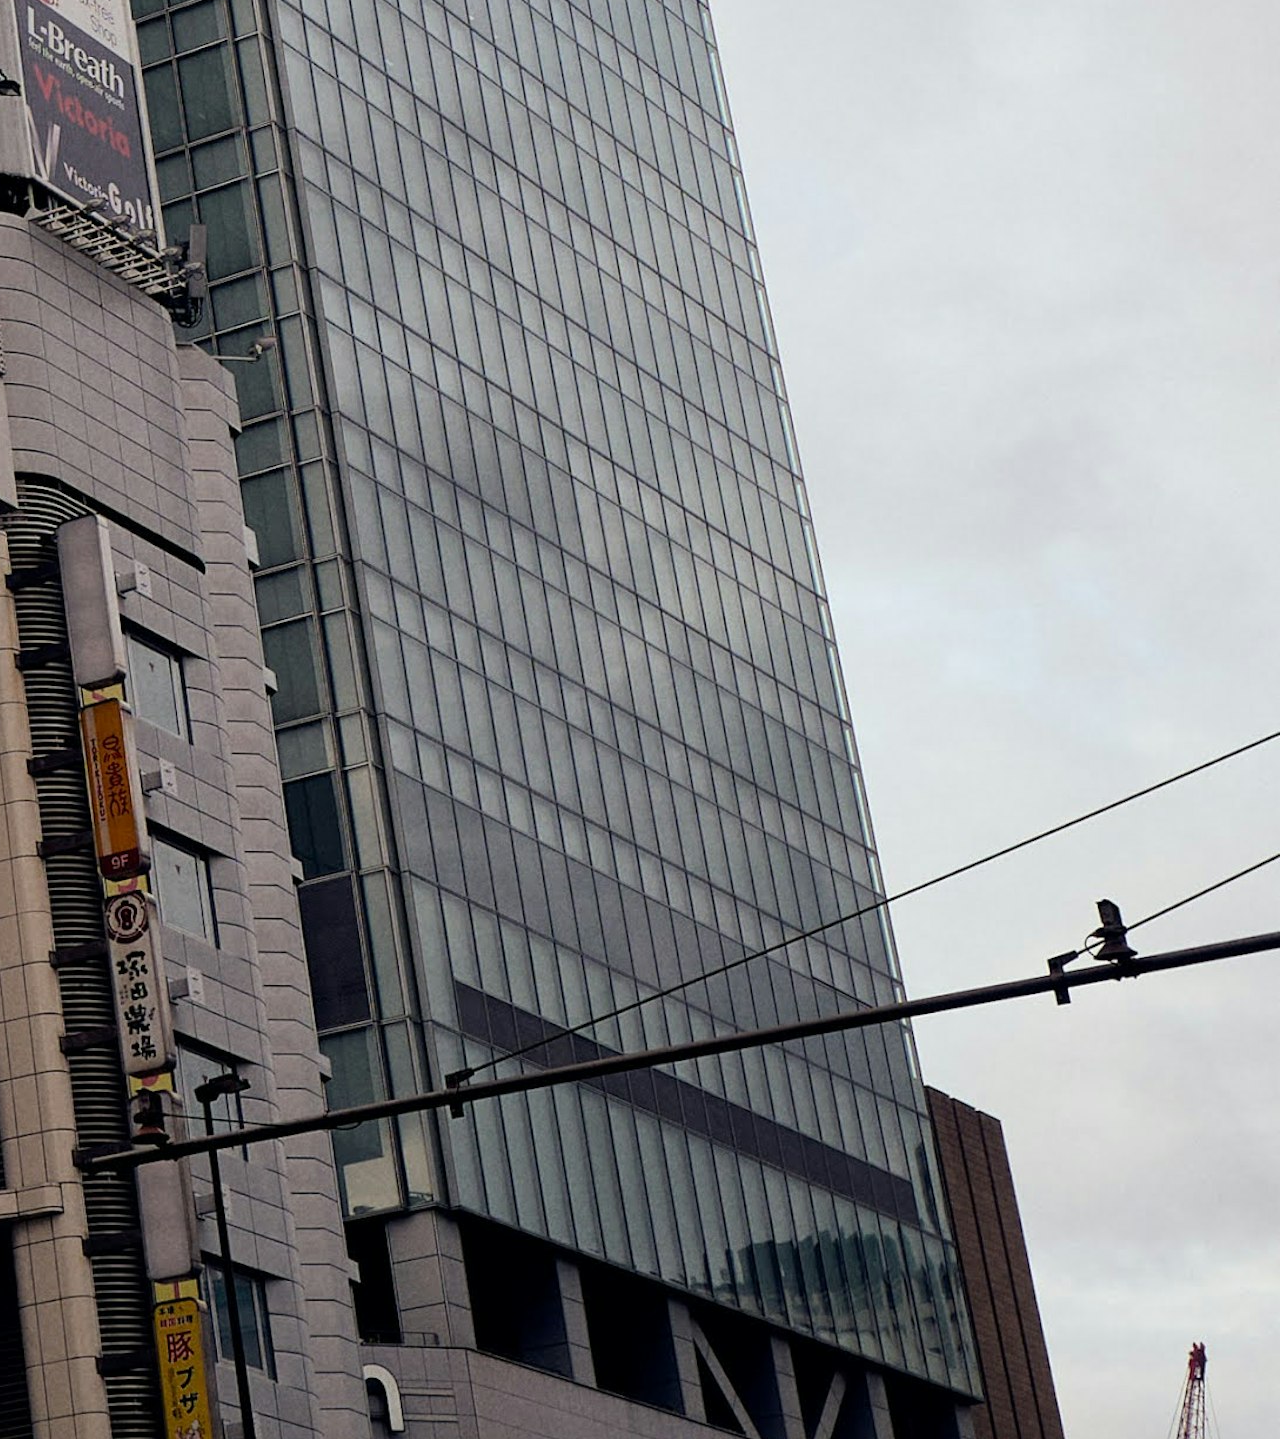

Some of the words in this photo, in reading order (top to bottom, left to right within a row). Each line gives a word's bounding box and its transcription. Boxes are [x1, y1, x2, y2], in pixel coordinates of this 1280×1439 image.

[26, 4, 125, 99] L-Breath
[34, 63, 131, 160] Victoria
[110, 852, 130, 871] 9F
